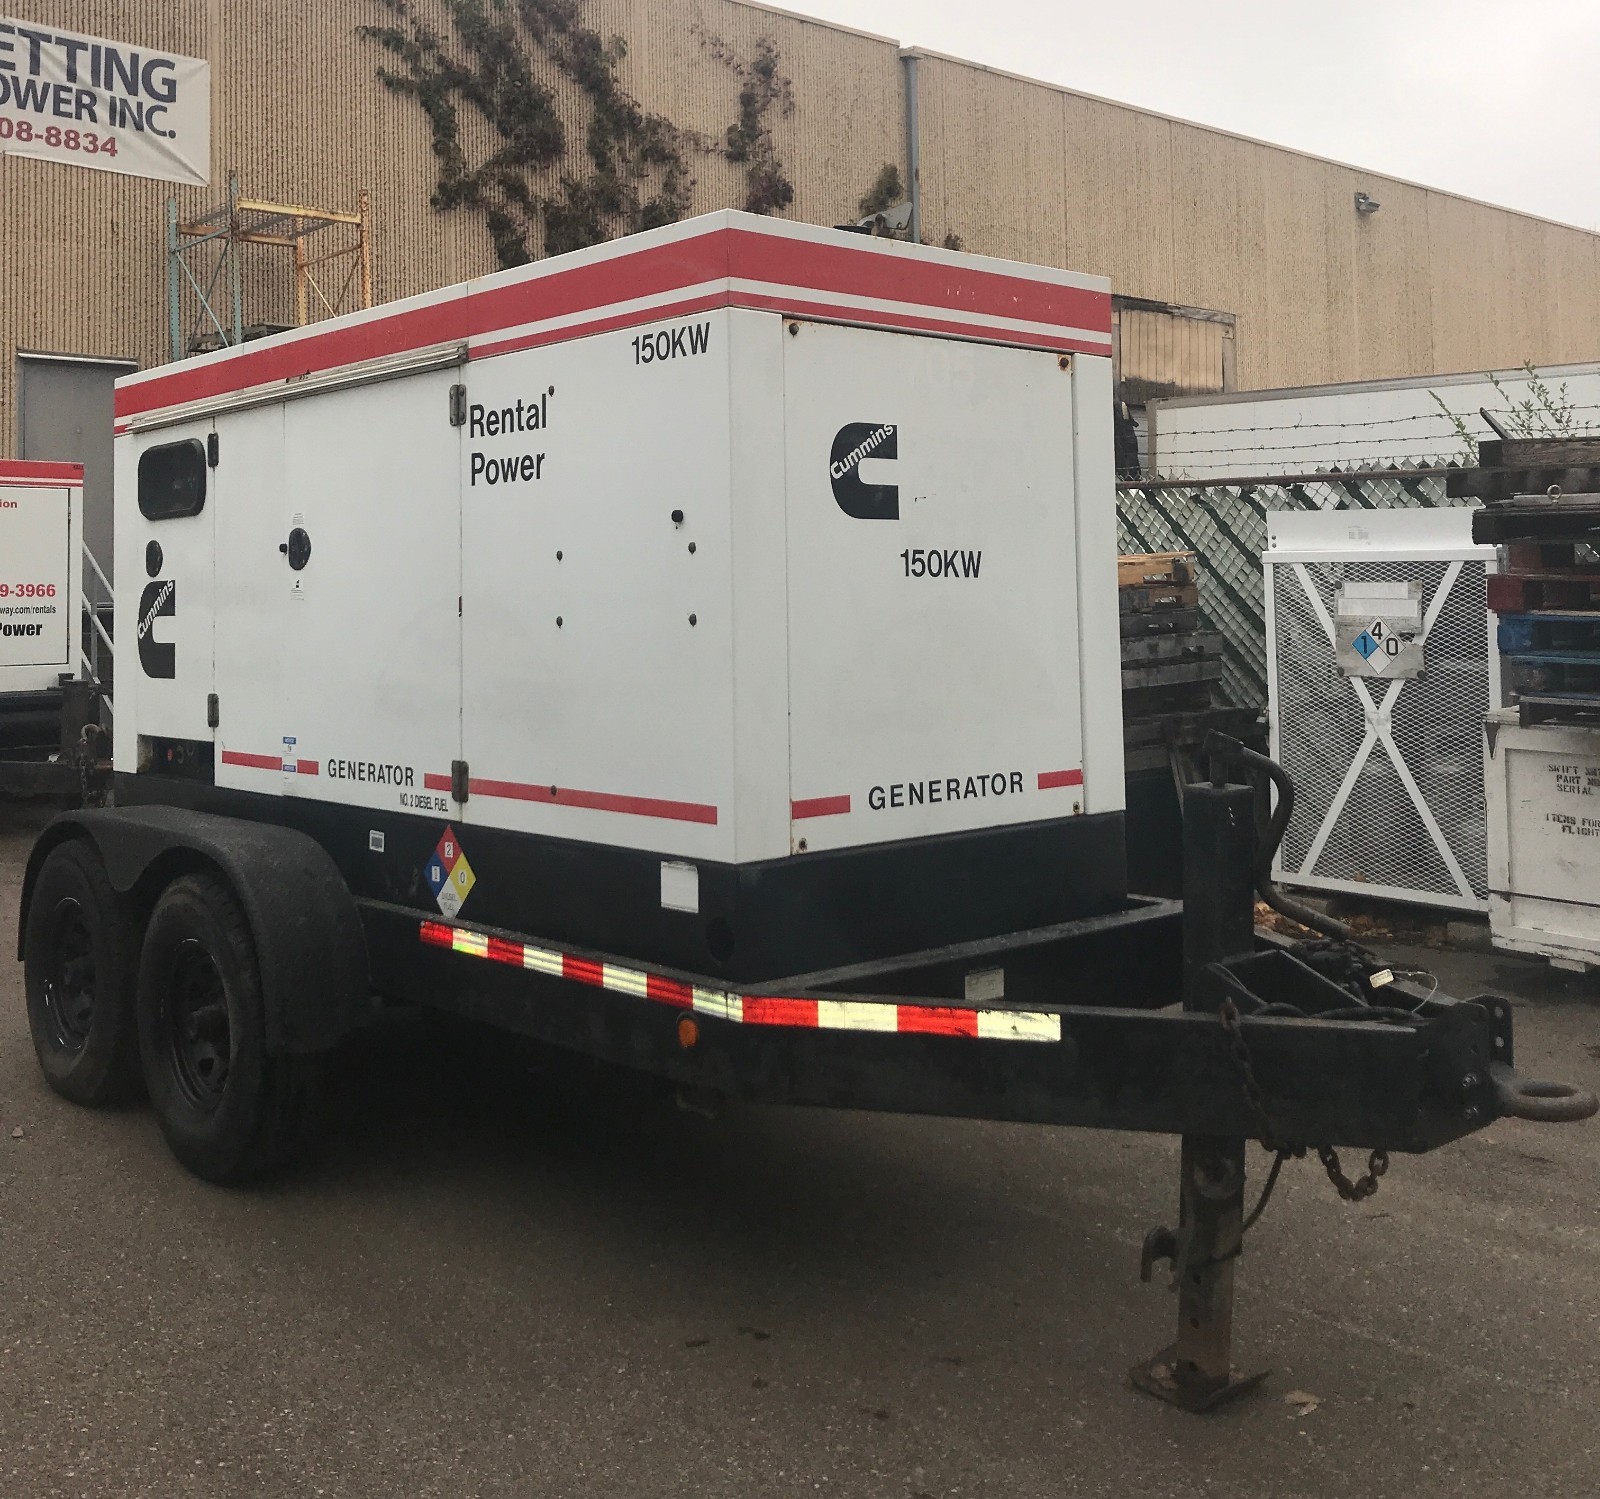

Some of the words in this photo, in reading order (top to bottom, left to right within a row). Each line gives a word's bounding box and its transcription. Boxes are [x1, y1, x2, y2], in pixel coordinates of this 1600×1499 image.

[109, 95, 177, 139] INC.
[0, 117, 118, 157] 08-8834
[632, 322, 711, 365] 150KW
[470, 393, 547, 439] Rental
[830, 423, 894, 480] Cummins
[471, 452, 545, 486] Power
[900, 549, 982, 578] 150KW
[0, 584, 56, 597] 9-3966
[137, 579, 174, 639] Cummins
[1361, 635, 1368, 654] 1
[1371, 621, 1383, 640] 4
[1386, 637, 1399, 656] 0
[328, 758, 414, 787] GENERATOR
[868, 771, 1023, 811] GENERATOR
[446, 843, 452, 856] 2
